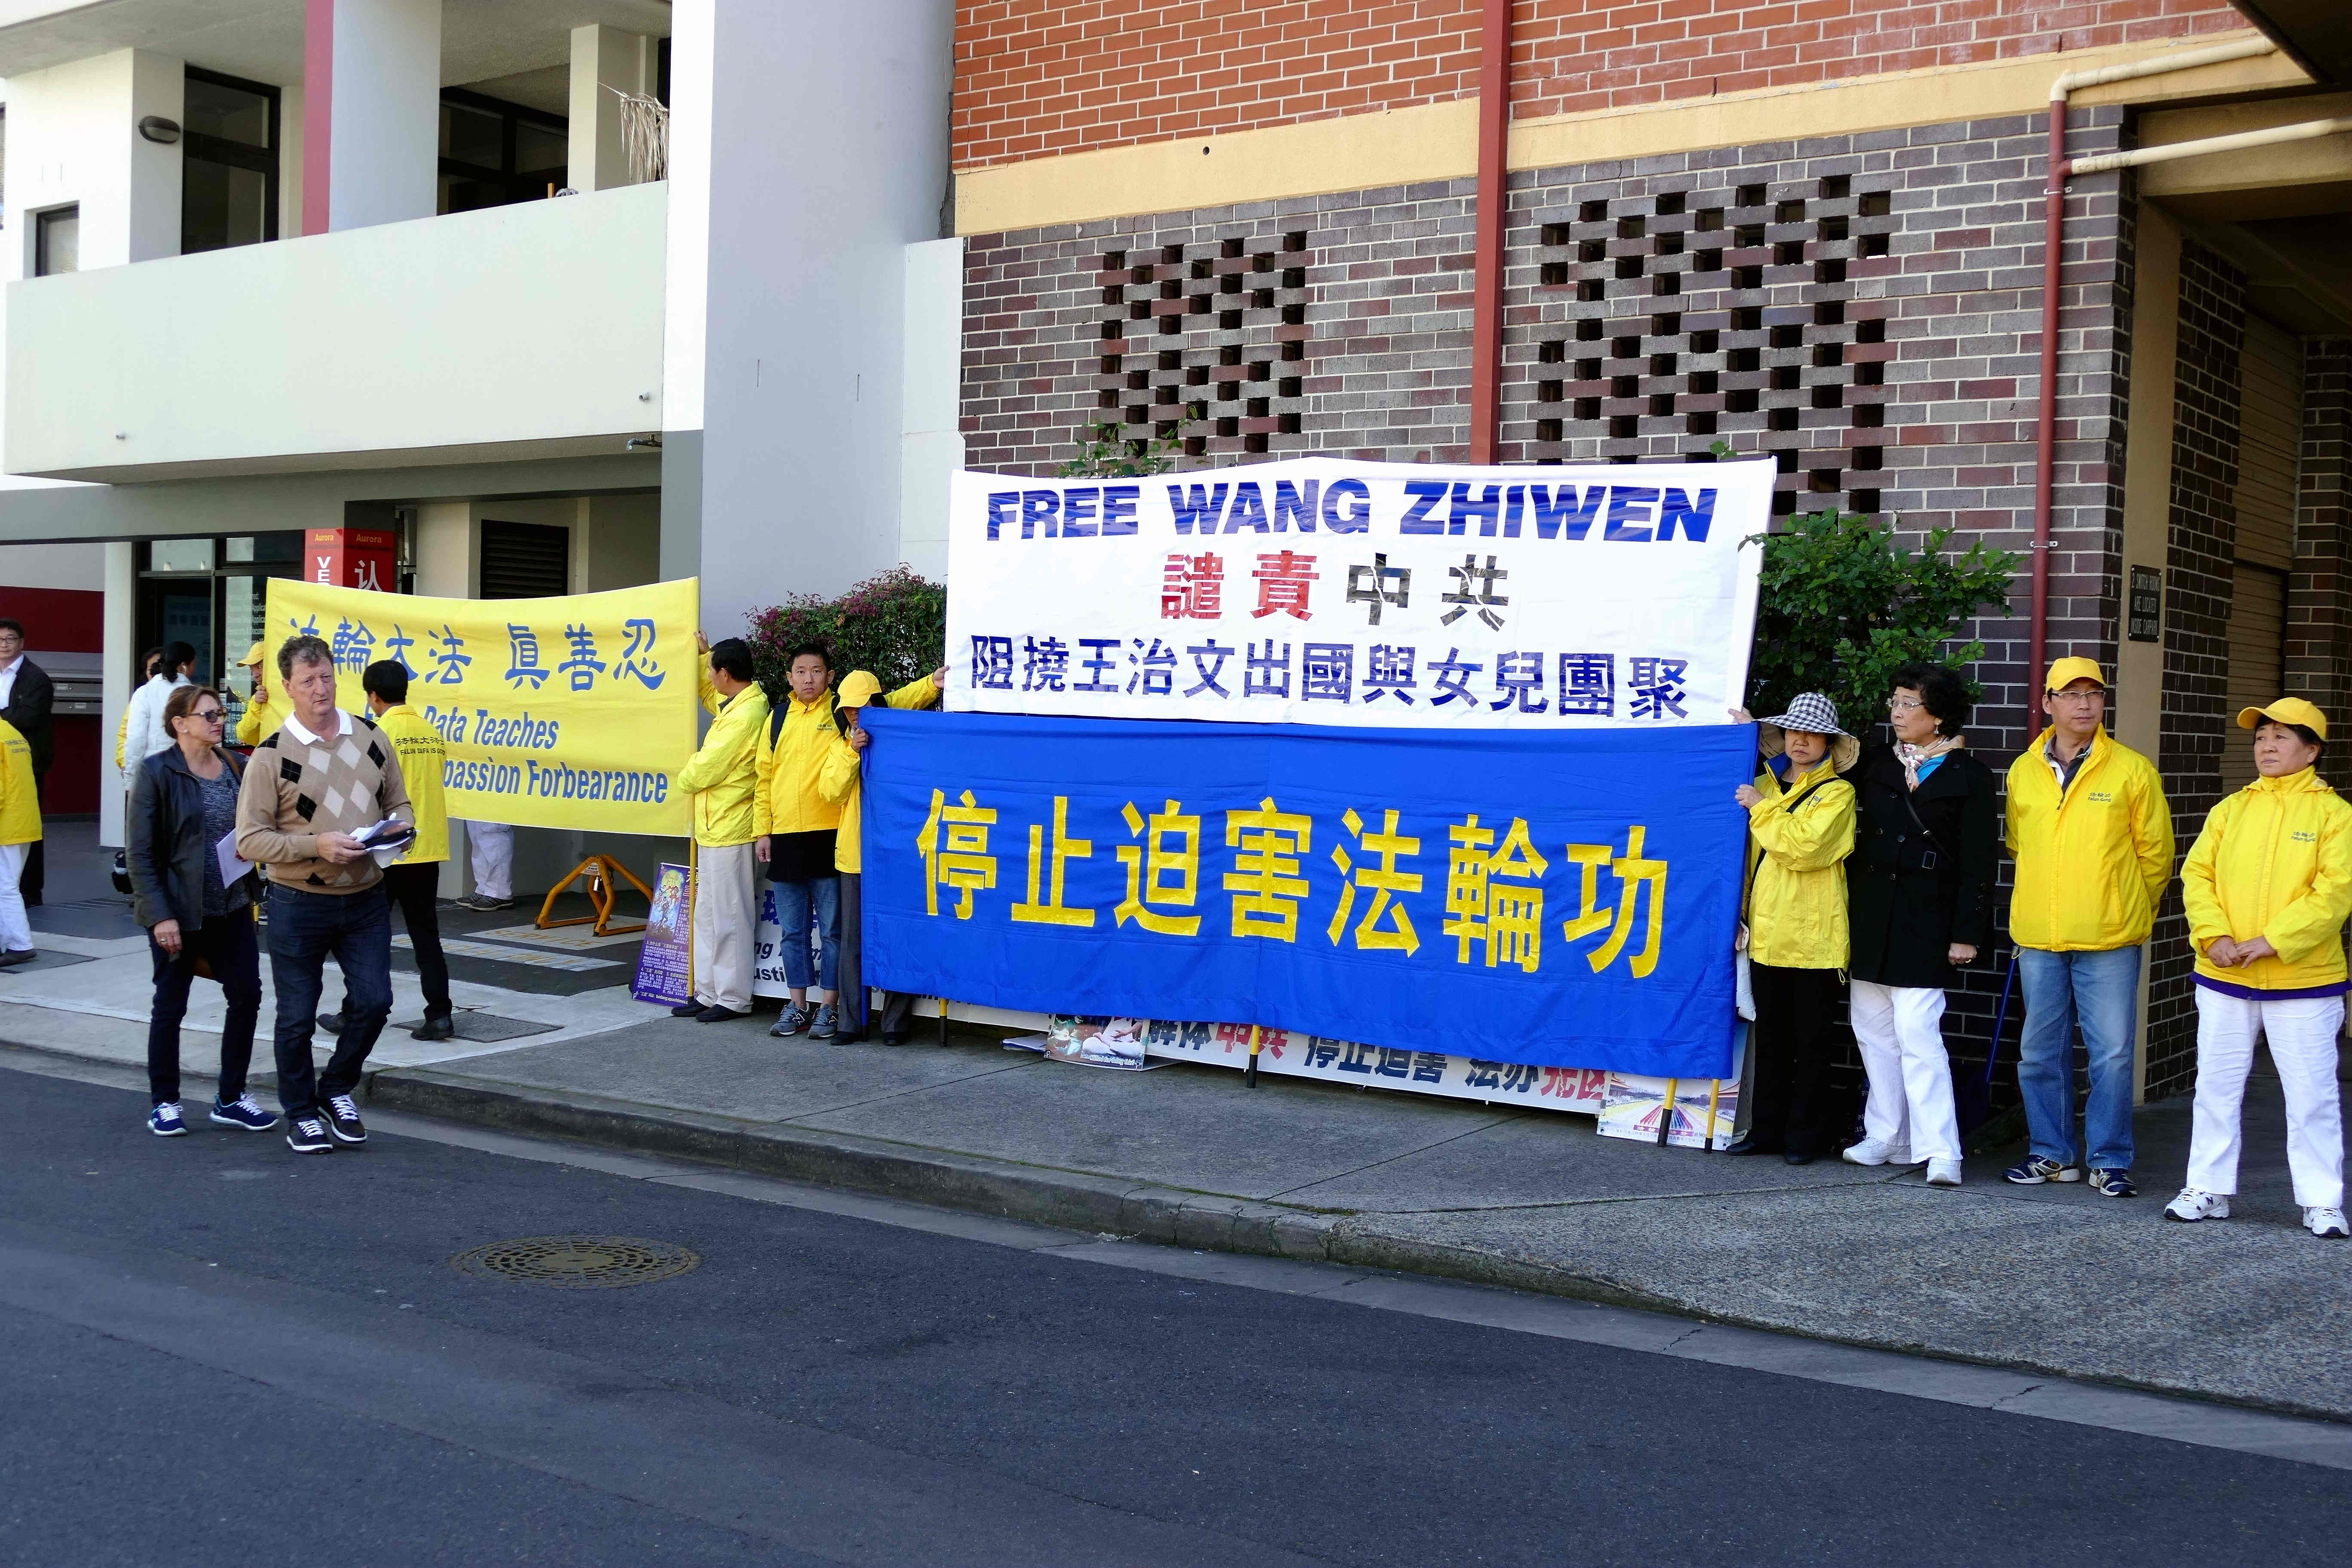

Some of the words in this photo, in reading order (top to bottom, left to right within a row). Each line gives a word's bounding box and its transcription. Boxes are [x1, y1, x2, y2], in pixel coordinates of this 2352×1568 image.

[987, 485, 1140, 541] FREE
[1166, 478, 1370, 534] WANG
[1400, 480, 1718, 542] ZHIWEN
[314, 533, 334, 542] Aurora
[356, 534, 382, 543] Aurora
[317, 556, 331, 585] VE
[355, 560, 382, 591] 认
[1161, 550, 1509, 632] 譴責中共
[2142, 596, 2156, 613] LOCATED
[252, 603, 265, 614] Applica
[252, 615, 265, 625] Applica
[970, 634, 1689, 720] 阻撓王治文出國與女兒團聚
[424, 705, 467, 743] Dafa
[473, 709, 559, 749] Teaches
[443, 756, 521, 794] passion
[526, 759, 668, 803] Forbearance
[916, 788, 1668, 978] 停止迫害法輪功
[753, 967, 785, 983] usti
[1090, 1054, 1104, 1062] Killed
[1111, 1057, 1124, 1066] doing
[1304, 1035, 1448, 1084] 停止迫害
